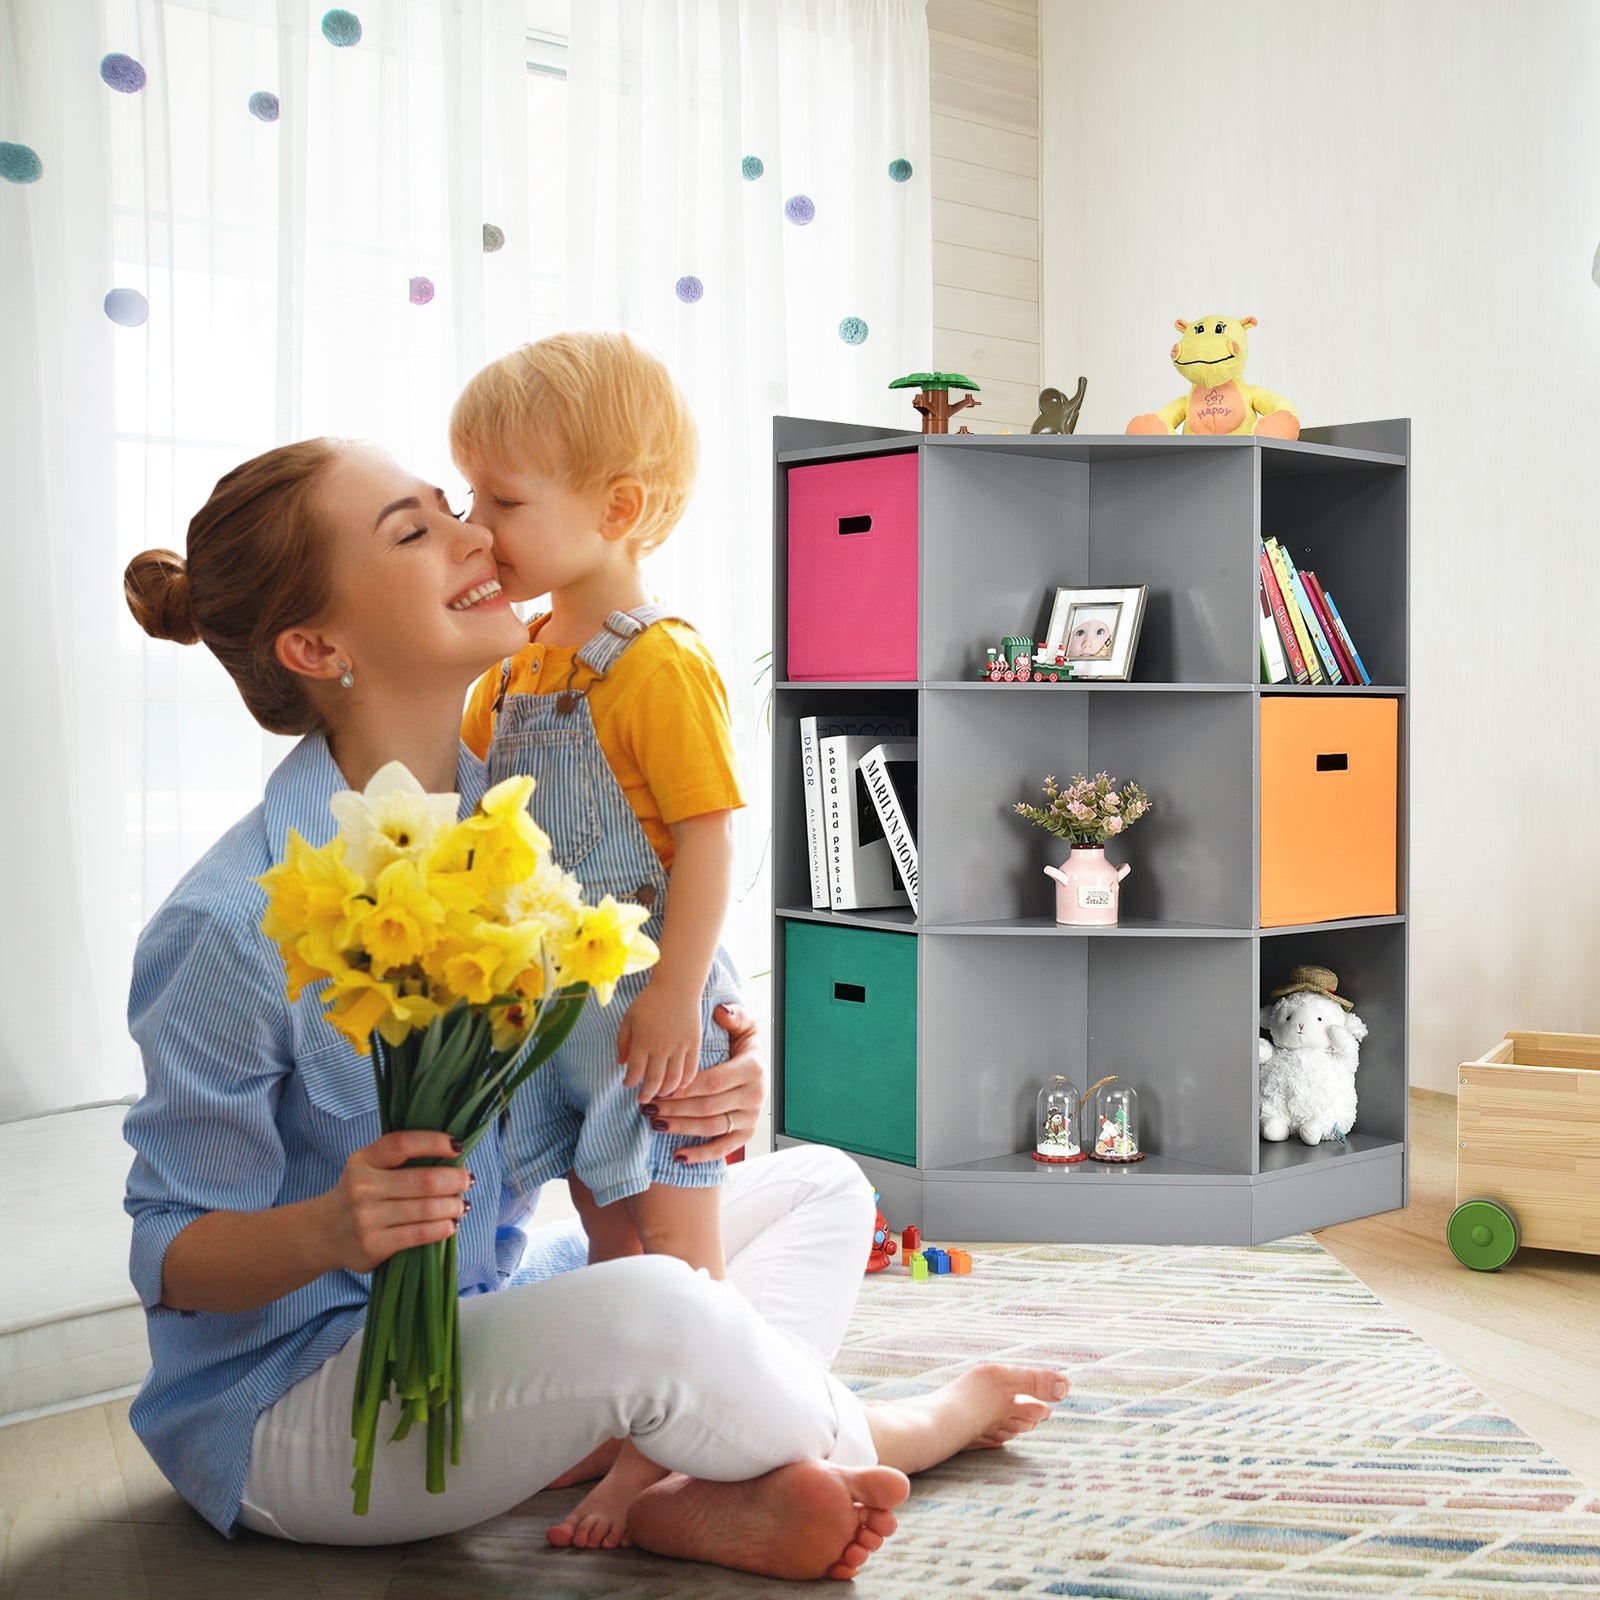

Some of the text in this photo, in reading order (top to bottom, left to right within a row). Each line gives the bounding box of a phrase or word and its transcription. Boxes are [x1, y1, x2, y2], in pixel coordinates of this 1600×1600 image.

[1197, 407, 1232, 419] Happy
[1275, 605, 1297, 652] garden
[804, 736, 815, 787] DECOR
[811, 827, 819, 872] AMERICAN
[828, 747, 842, 904] speed and passion
[865, 759, 918, 902] MARILYN MONRO
